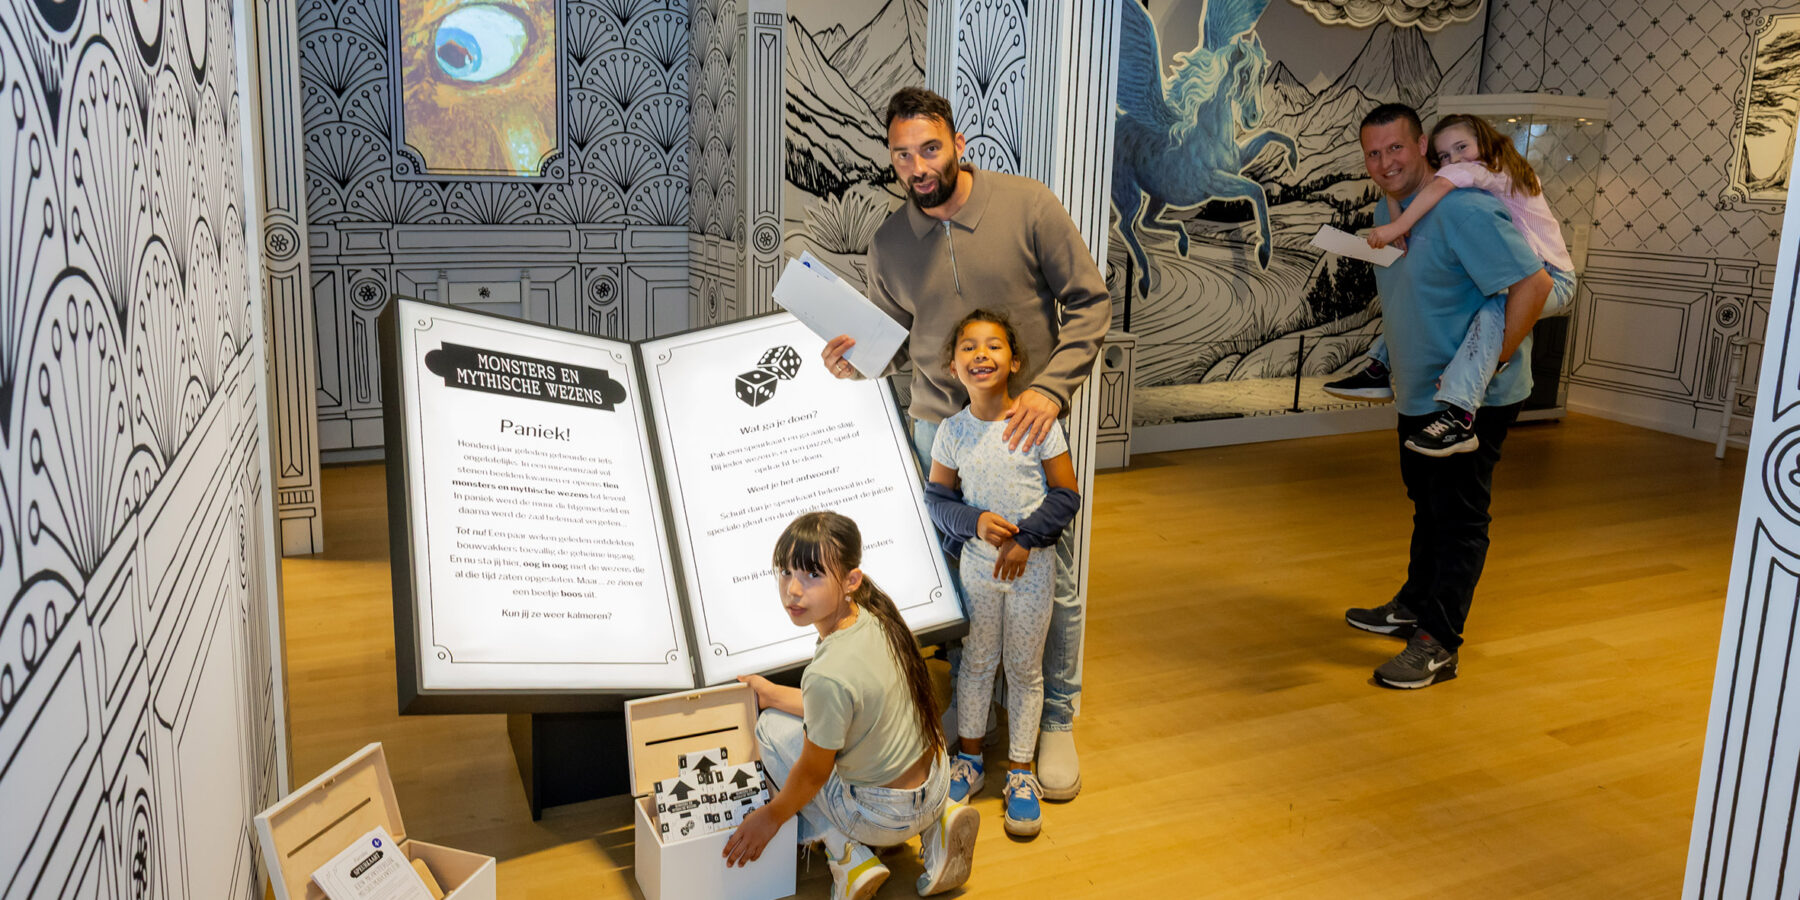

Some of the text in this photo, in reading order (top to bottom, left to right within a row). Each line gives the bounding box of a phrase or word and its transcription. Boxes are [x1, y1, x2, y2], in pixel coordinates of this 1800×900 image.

[477, 353, 580, 385] MONSTERS EN
[456, 367, 603, 405] MYTHISCHE WEZENS
[500, 419, 571, 442] Paniek!
[740, 410, 818, 436] Wat ga je doen?
[458, 439, 496, 451] Honderd
[514, 448, 548, 457] geleden
[549, 453, 587, 462] gebeurde
[710, 451, 726, 460] Pak
[727, 448, 743, 456] een
[743, 436, 786, 452] speurkaart
[800, 432, 810, 440] ga
[810, 428, 825, 436] aan
[711, 464, 722, 472] Bij
[723, 460, 743, 469] ieder
[744, 454, 771, 464] wezen
[834, 433, 850, 443] spel
[851, 430, 860, 438] of
[521, 460, 529, 468] In
[754, 460, 790, 474] opdracht
[452, 479, 496, 490] monsters
[510, 486, 556, 496] mythische
[557, 491, 588, 500] wezens
[457, 466, 488, 476] stenen
[490, 469, 525, 480] beelden
[526, 473, 561, 484] kwamen
[603, 482, 619, 490] tien
[747, 483, 769, 495] Weet
[780, 477, 794, 487] het
[796, 465, 840, 484] antwoord?
[454, 491, 463, 500] In
[464, 494, 494, 503] paniek
[720, 508, 746, 520] Schuif
[748, 506, 764, 514] dan
[773, 491, 817, 508] speurkaart
[818, 482, 855, 497] helemaal
[864, 477, 875, 485] de
[458, 506, 490, 517] daarna
[546, 514, 584, 524] helemaal
[707, 523, 741, 537] speciale
[742, 517, 763, 529] gleuf
[779, 509, 796, 519] druk
[808, 504, 819, 513] de
[841, 494, 858, 504] met
[860, 491, 871, 499] de
[456, 526, 635, 547] Tot nu! Een paar weken geleden ontdekten
[457, 540, 518, 553] bouwvakkers
[519, 546, 556, 556] toevallig
[570, 550, 606, 558] geheime
[450, 554, 462, 564] En
[478, 557, 492, 565] sta
[494, 559, 502, 568] jij
[523, 561, 541, 570] oog
[542, 561, 550, 569] in
[552, 563, 569, 571] oog
[632, 566, 645, 574] die
[733, 575, 750, 584] Ben
[751, 572, 759, 581] jij
[863, 539, 894, 552] onsters
[455, 570, 463, 579] al
[465, 570, 480, 579] die
[481, 571, 496, 581] tijd
[498, 573, 523, 582] zaten
[531, 588, 560, 599] beetje
[561, 589, 583, 598] boos
[502, 609, 520, 618] Kun
[521, 610, 530, 620] jij
[531, 611, 541, 619] ze
[567, 611, 612, 620] kalmeren?
